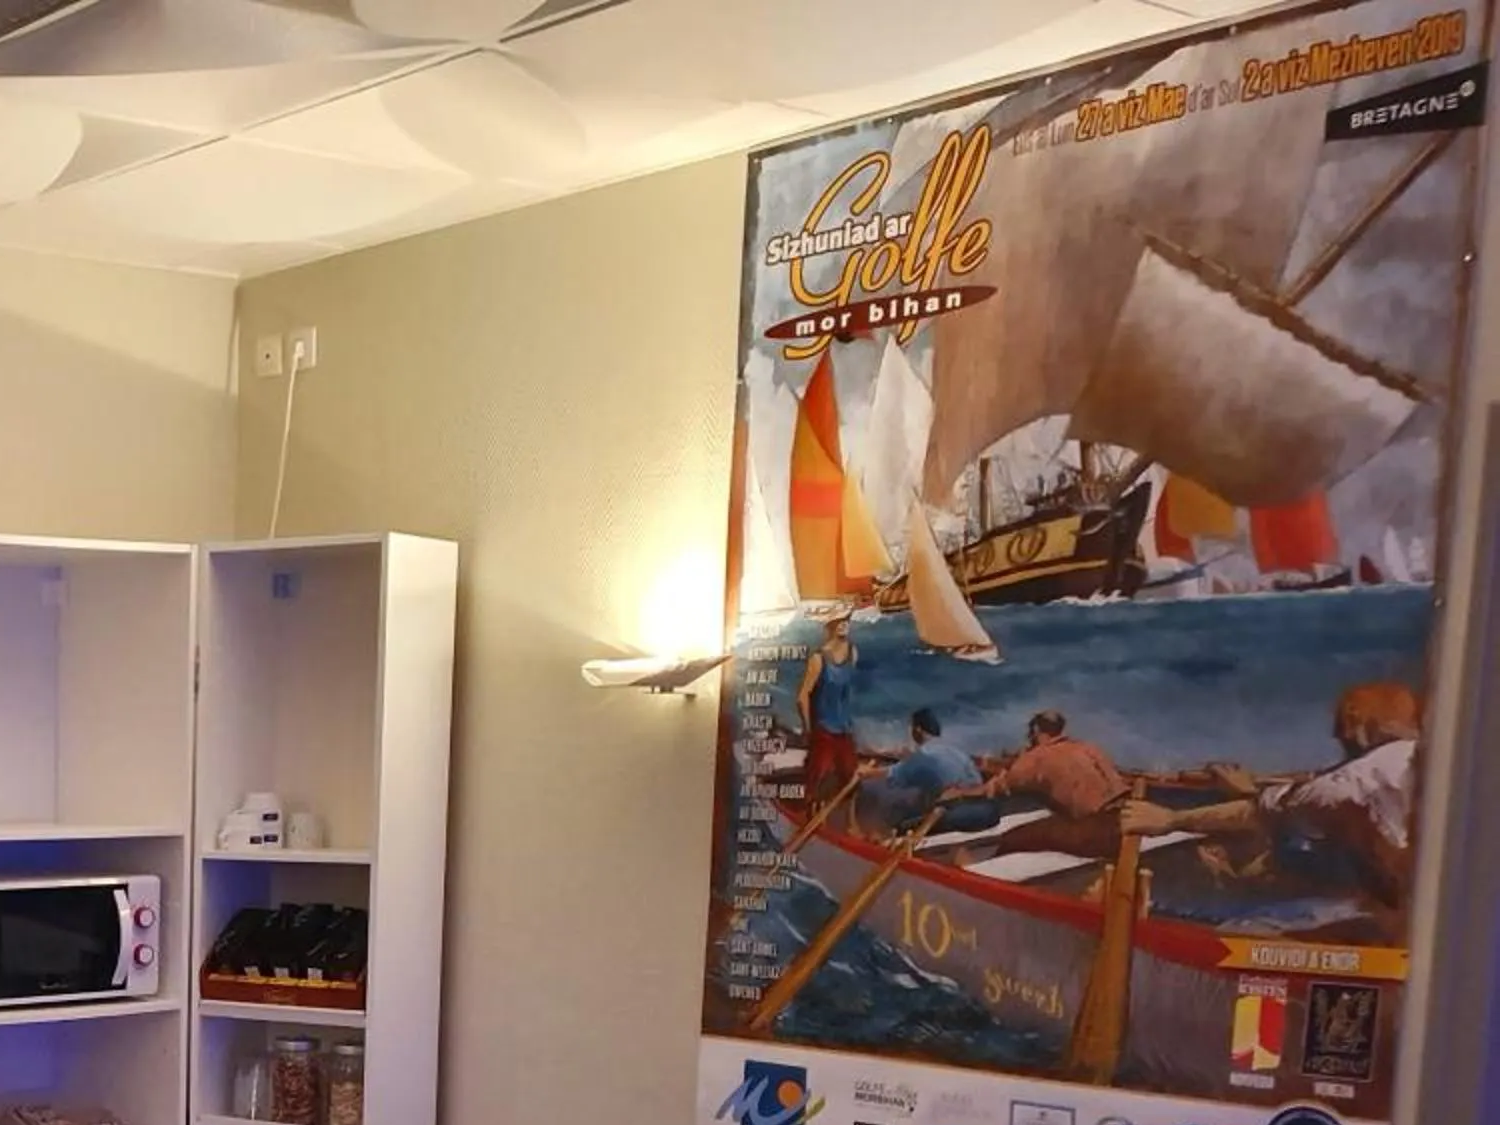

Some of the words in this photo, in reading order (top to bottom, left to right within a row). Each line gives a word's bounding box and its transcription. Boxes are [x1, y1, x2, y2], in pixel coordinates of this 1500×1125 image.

[1075, 98, 1101, 142] 27
[1100, 101, 1116, 137] a
[1116, 89, 1147, 133] viz
[1145, 81, 1188, 124] Mae
[1240, 58, 1261, 102] 2
[1349, 92, 1460, 130] BRETAGNE
[782, 122, 993, 361] Golfe
[883, 211, 914, 241] ar
[794, 312, 852, 338] mor
[867, 290, 962, 324] bihan
